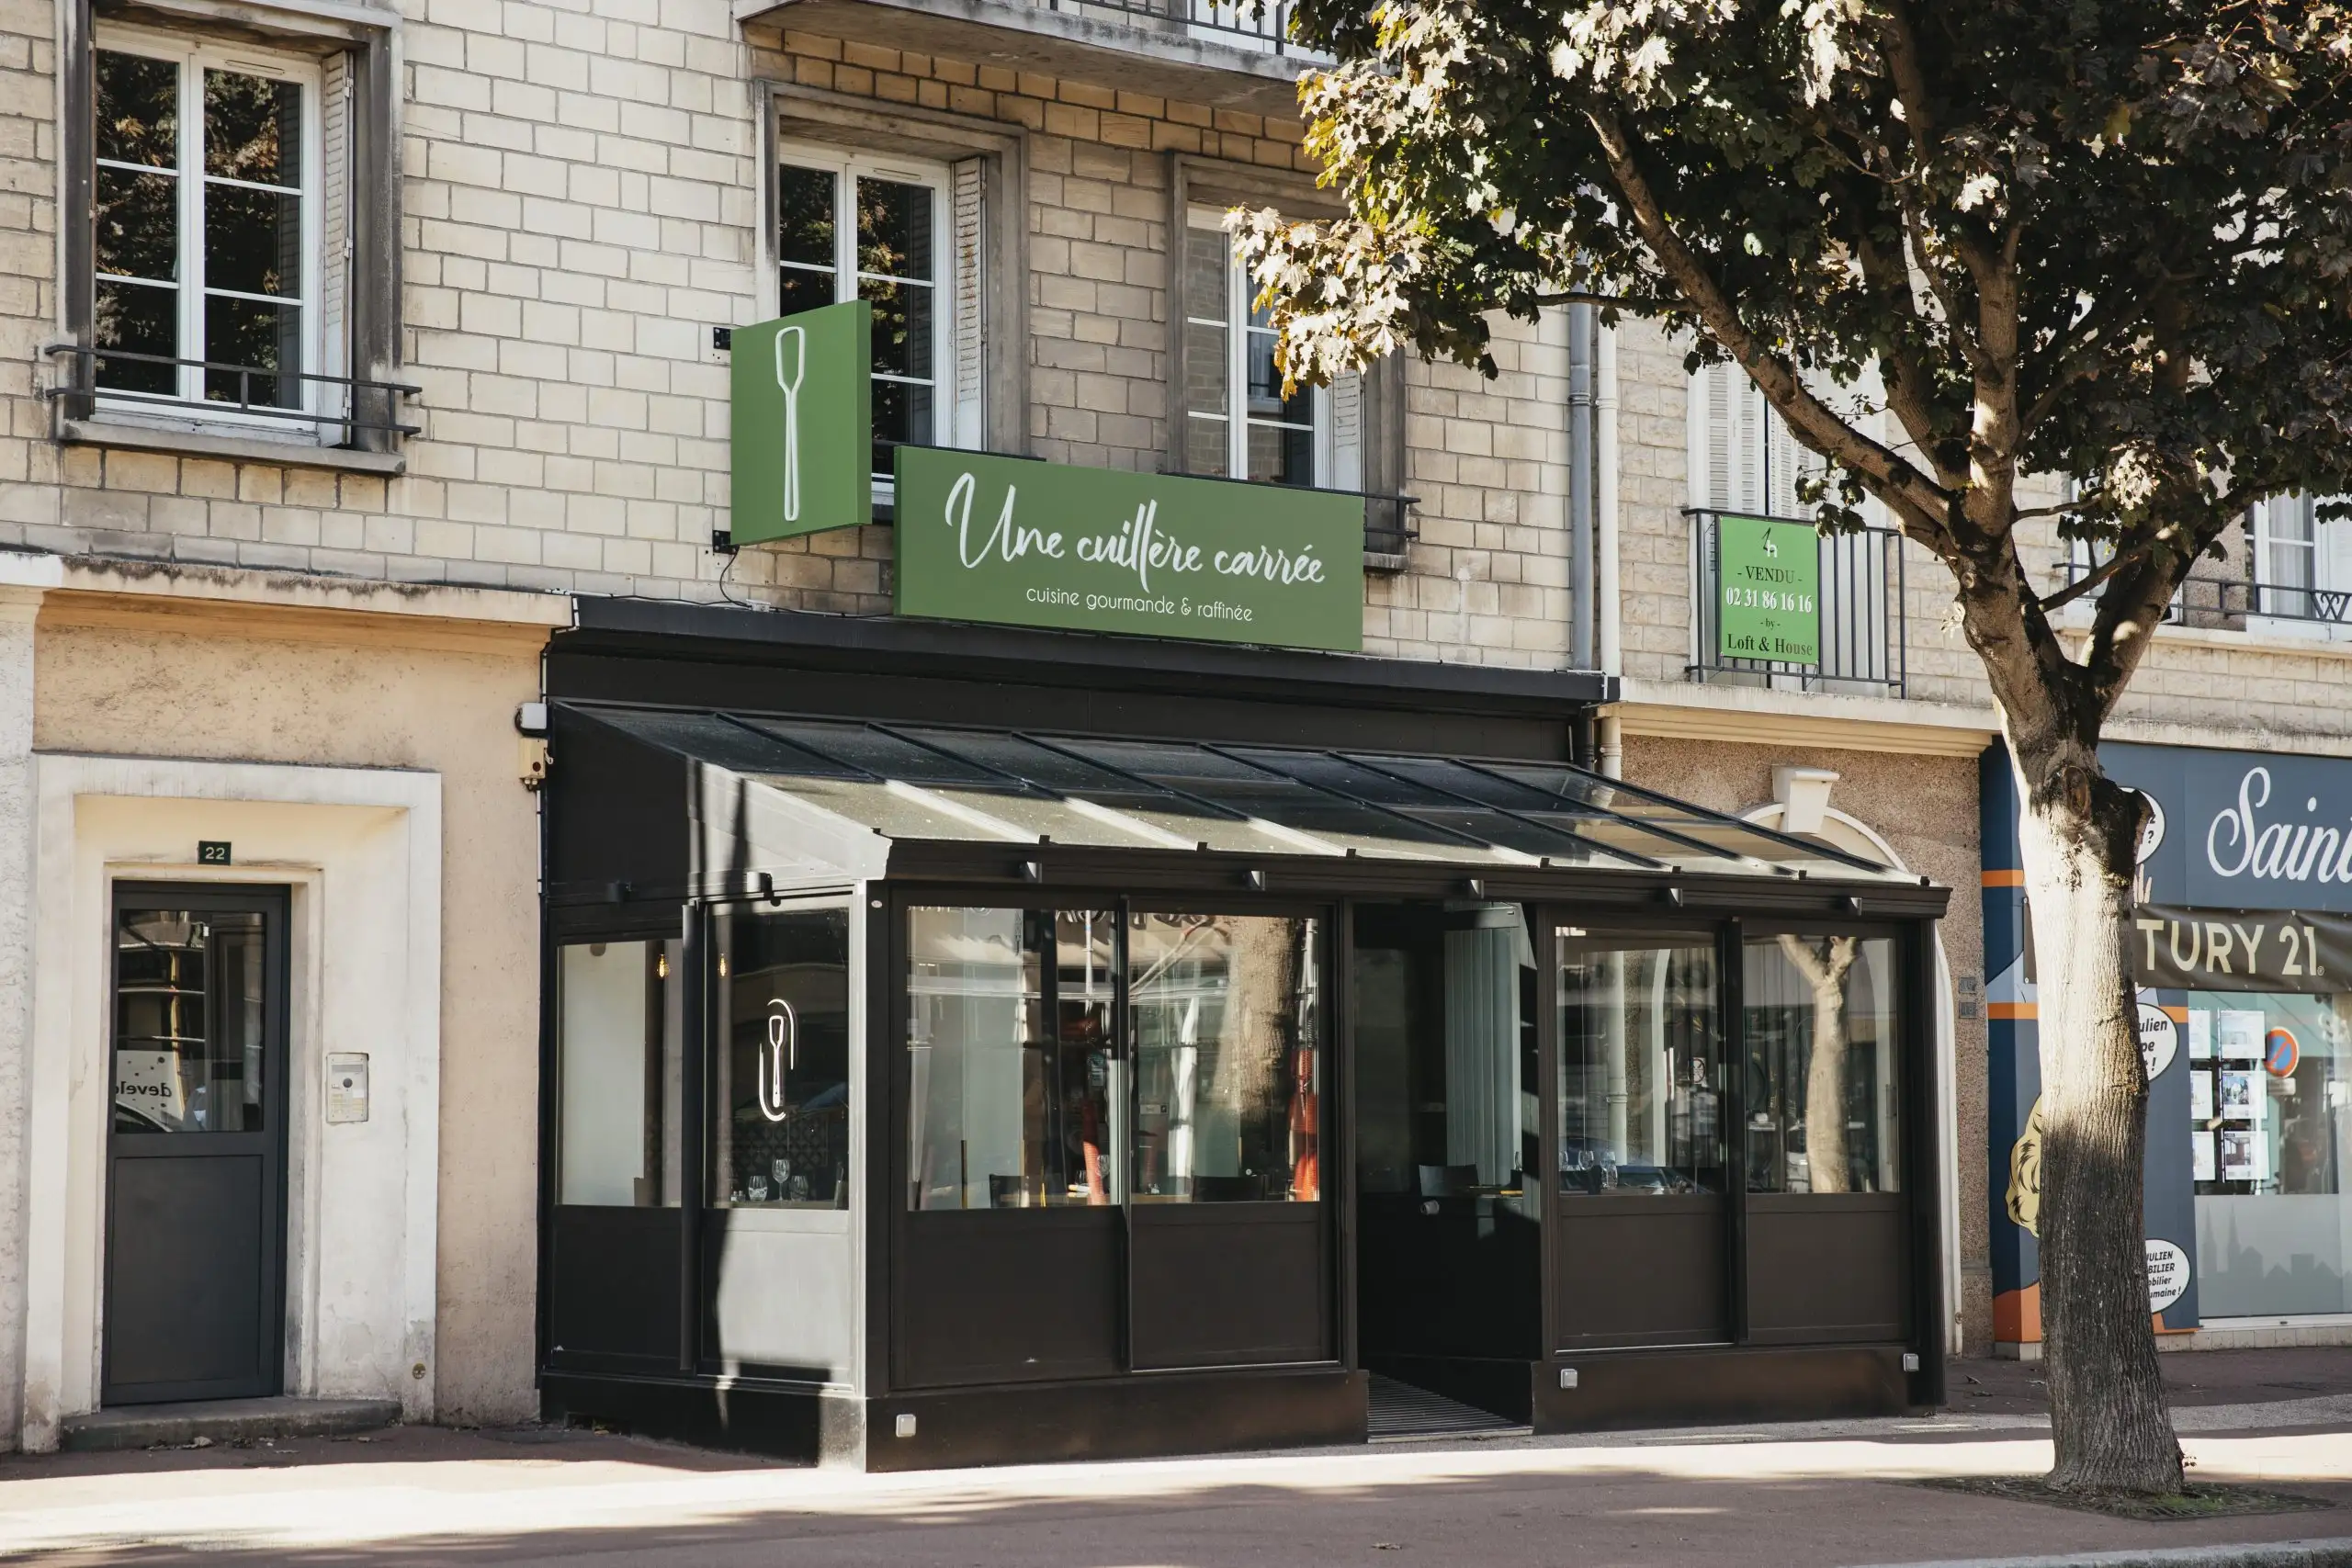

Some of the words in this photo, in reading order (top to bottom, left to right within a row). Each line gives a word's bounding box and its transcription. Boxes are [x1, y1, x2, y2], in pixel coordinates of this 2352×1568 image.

[944, 472, 1065, 569] Une
[1077, 499, 1203, 593] cuillère
[1214, 543, 1325, 584] carrée
[1746, 566, 1795, 584] VENDU
[1026, 587, 1080, 607] cuisine
[1086, 591, 1176, 615] gourmande
[1181, 597, 1192, 616] &
[1197, 601, 1253, 622] raffinée
[1725, 587, 1742, 606] 02
[1744, 589, 1758, 607] 31
[1762, 591, 1777, 610] 86
[1781, 592, 1795, 613] 16
[1799, 594, 1813, 614] 16
[1766, 617, 1776, 629] by
[1727, 634, 1755, 650] Loft
[1759, 637, 1770, 651] &
[1775, 638, 1813, 655] House
[205, 846, 225, 860] 22
[2136, 919, 2264, 975] TURY
[2139, 1018, 2167, 1032] ulien
